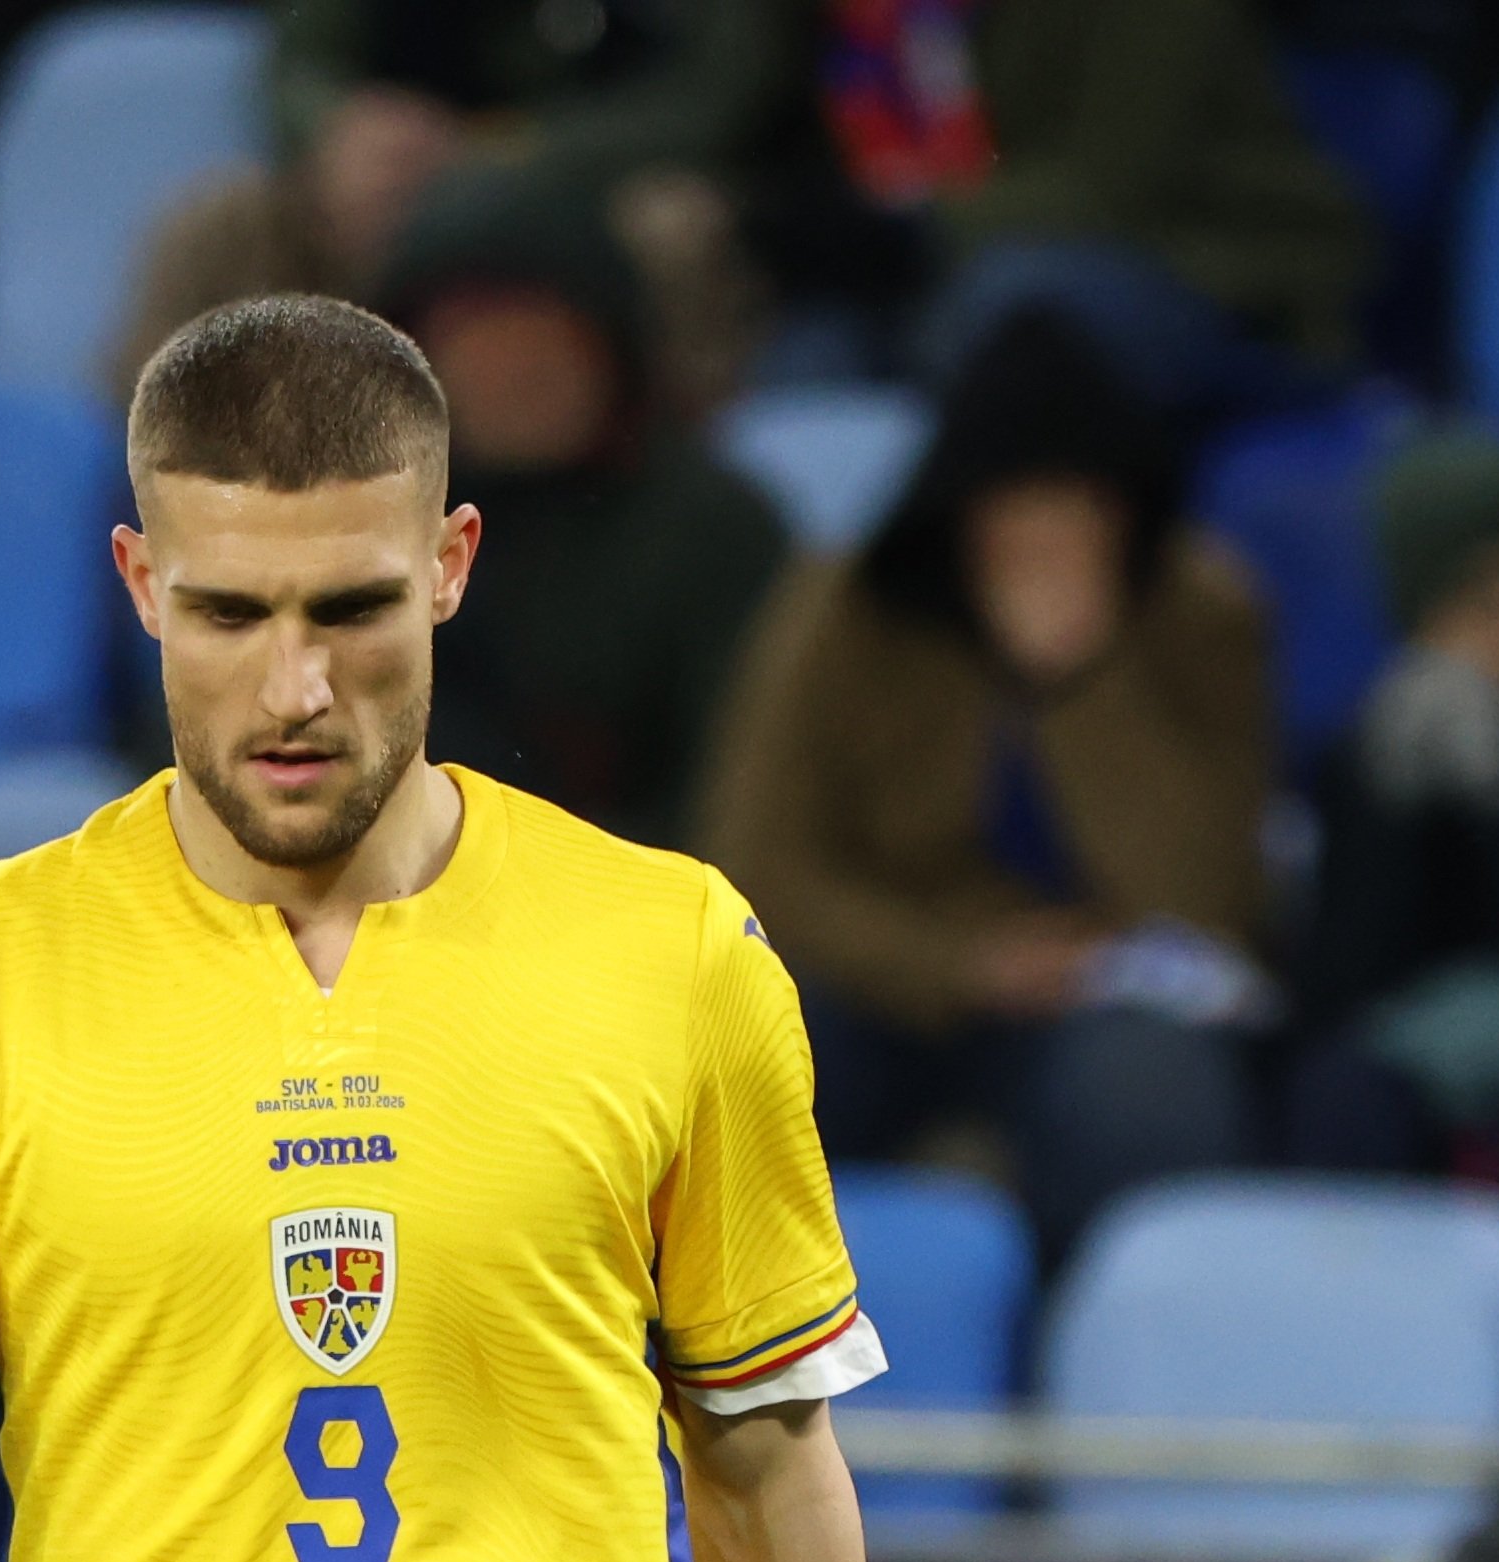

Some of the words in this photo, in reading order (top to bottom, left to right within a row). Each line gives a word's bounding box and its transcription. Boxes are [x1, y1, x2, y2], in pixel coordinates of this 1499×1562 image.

[281, 1078, 318, 1097] SVK
[342, 1075, 380, 1093] ROU
[343, 1096, 405, 1109] 31.03.2026
[285, 1212, 383, 1247] ROMÂNIA
